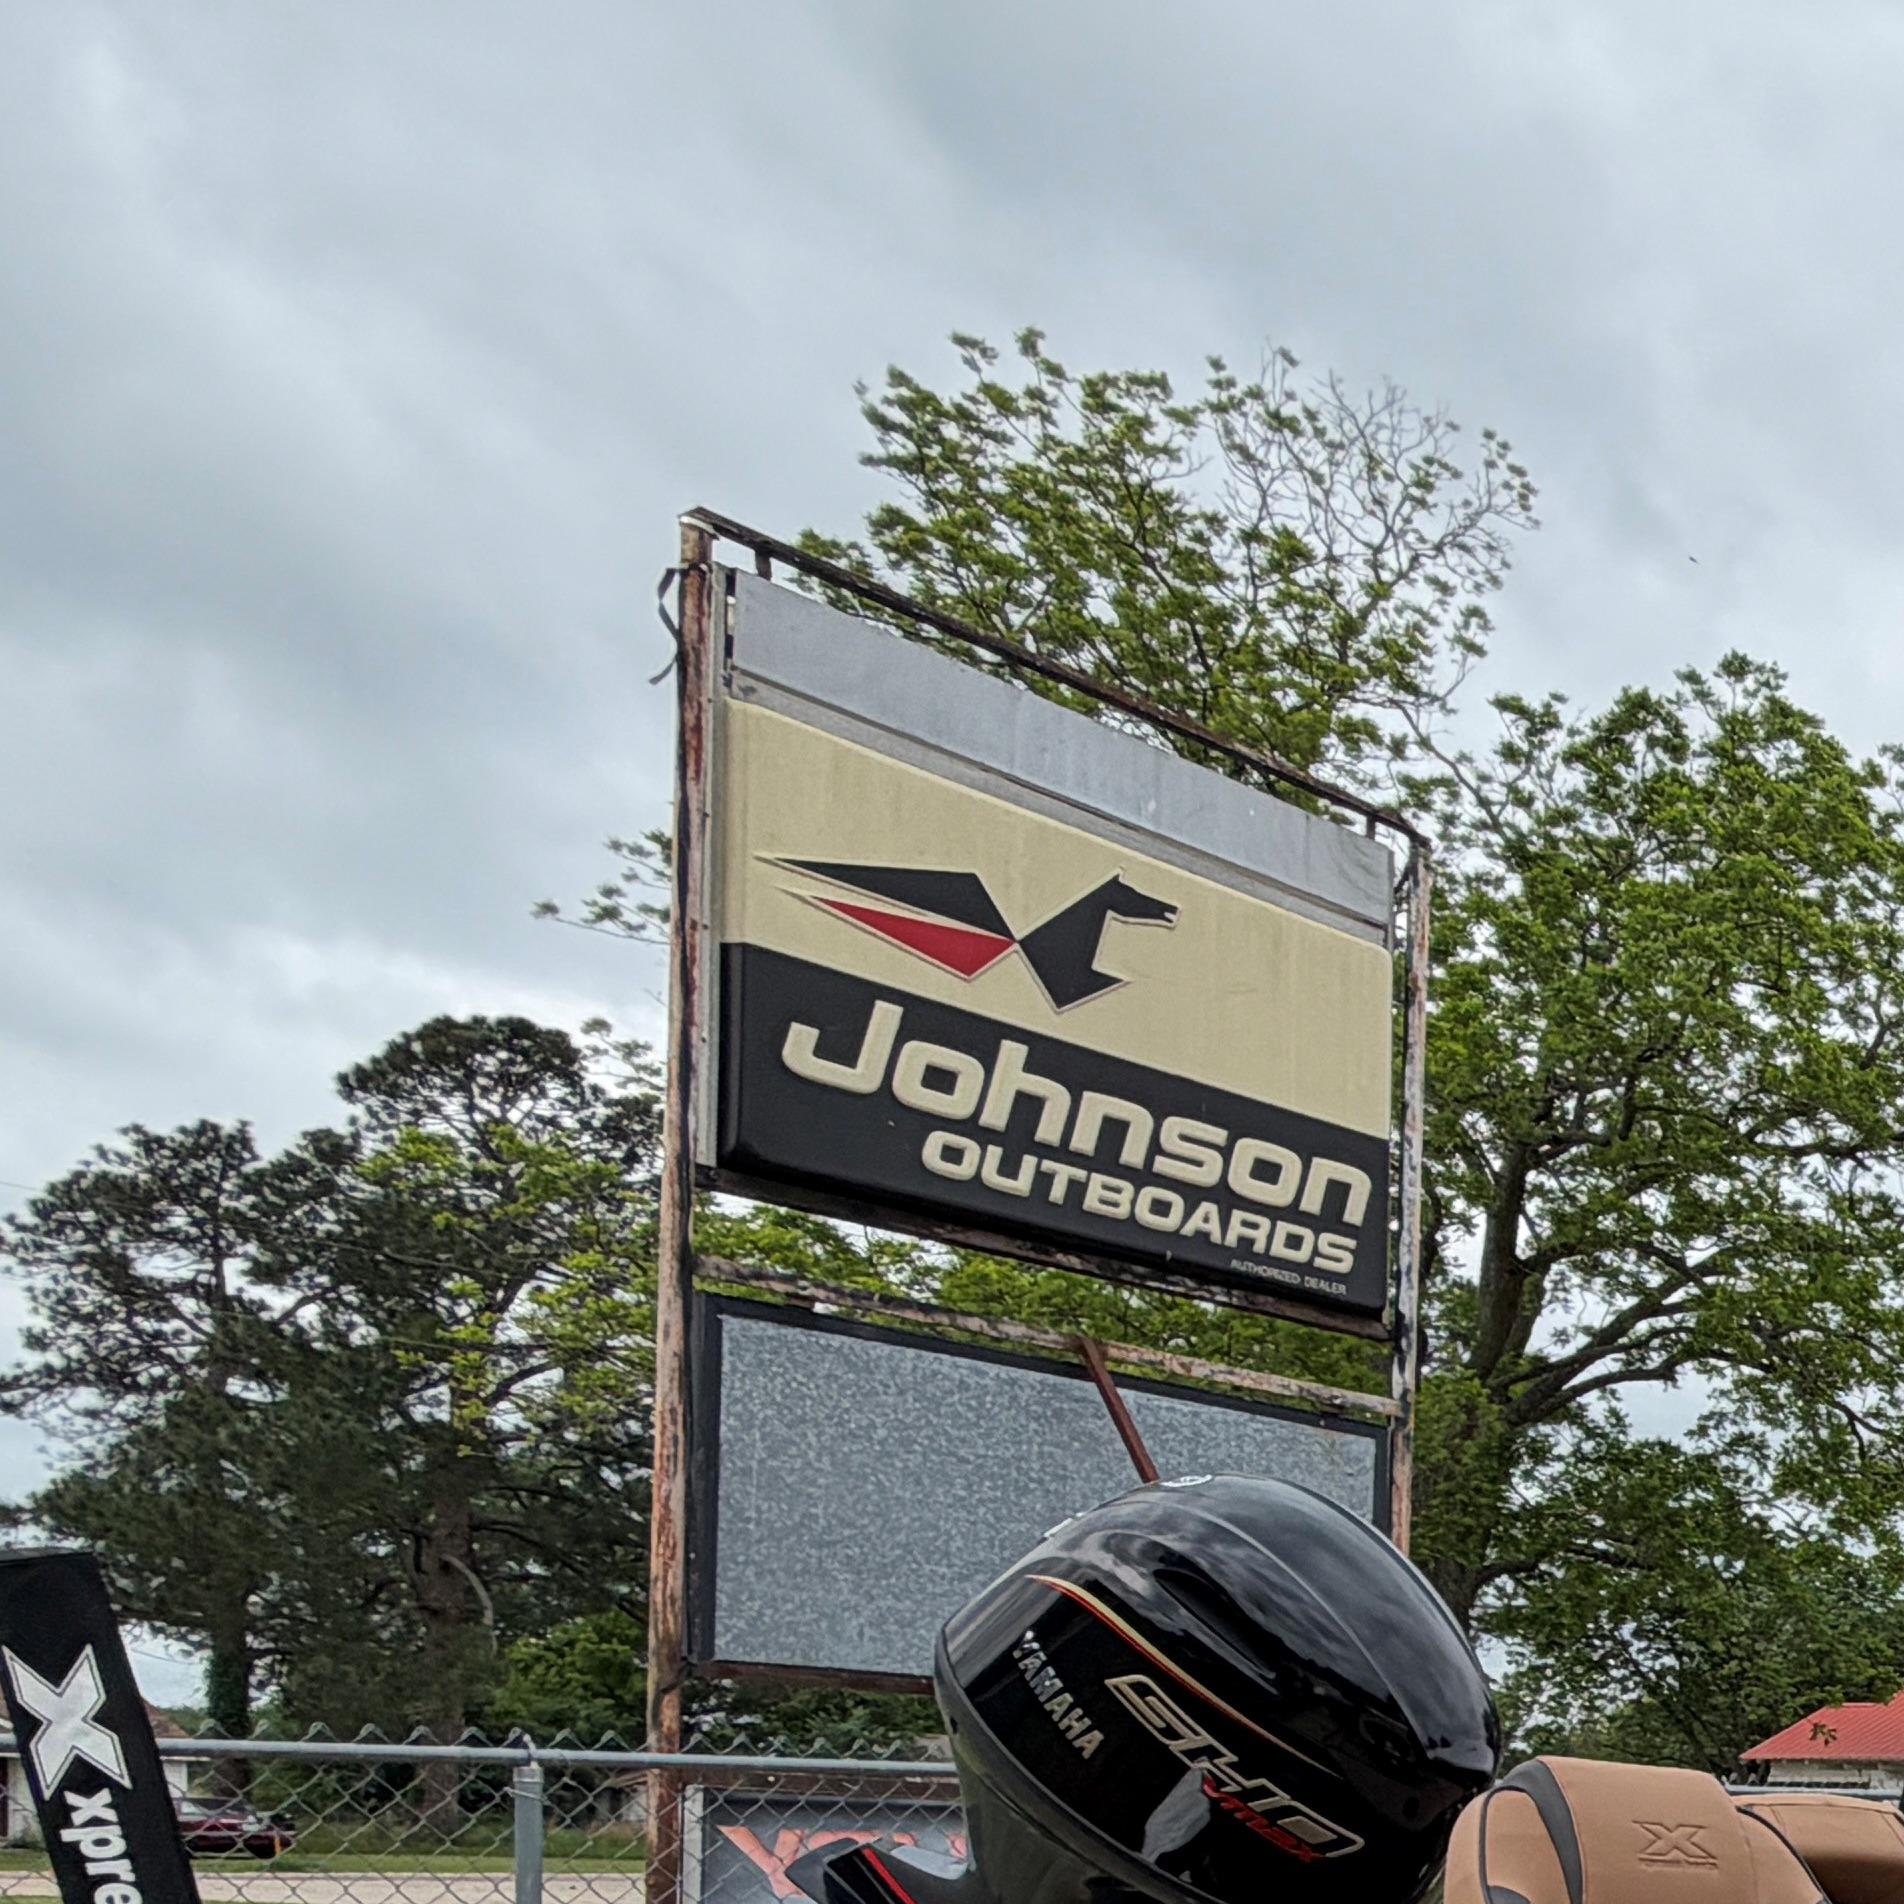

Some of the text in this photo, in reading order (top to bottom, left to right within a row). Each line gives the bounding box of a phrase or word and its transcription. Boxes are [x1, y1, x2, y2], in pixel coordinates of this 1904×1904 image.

[781, 999, 1372, 1227] Johnson
[920, 1130, 1358, 1274] OUTBOARDS
[1230, 1258, 1347, 1296] AUTHORIZED DEALER
[1012, 1630, 1105, 1760] YAMAHA
